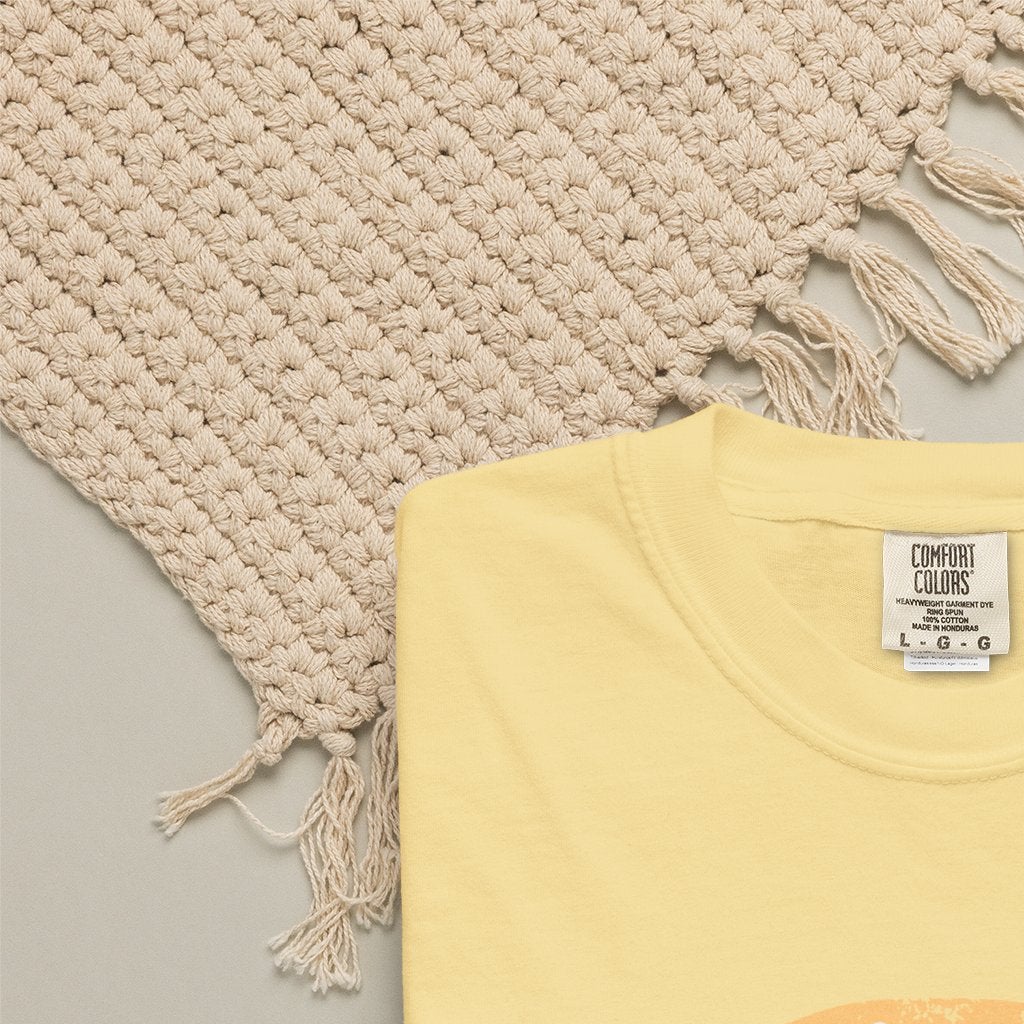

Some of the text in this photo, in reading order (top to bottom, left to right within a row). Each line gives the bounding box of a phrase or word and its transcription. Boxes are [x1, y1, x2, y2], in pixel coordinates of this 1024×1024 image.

[911, 543, 976, 568] COMFORT
[896, 597, 944, 608] HEAVYWEIGHT
[945, 600, 979, 609] GARMENT
[926, 608, 943, 616] RING
[922, 616, 939, 624] 100%
[912, 623, 931, 631] MADE
[900, 633, 910, 647] L
[936, 635, 950, 650] G
[977, 636, 991, 650] G
